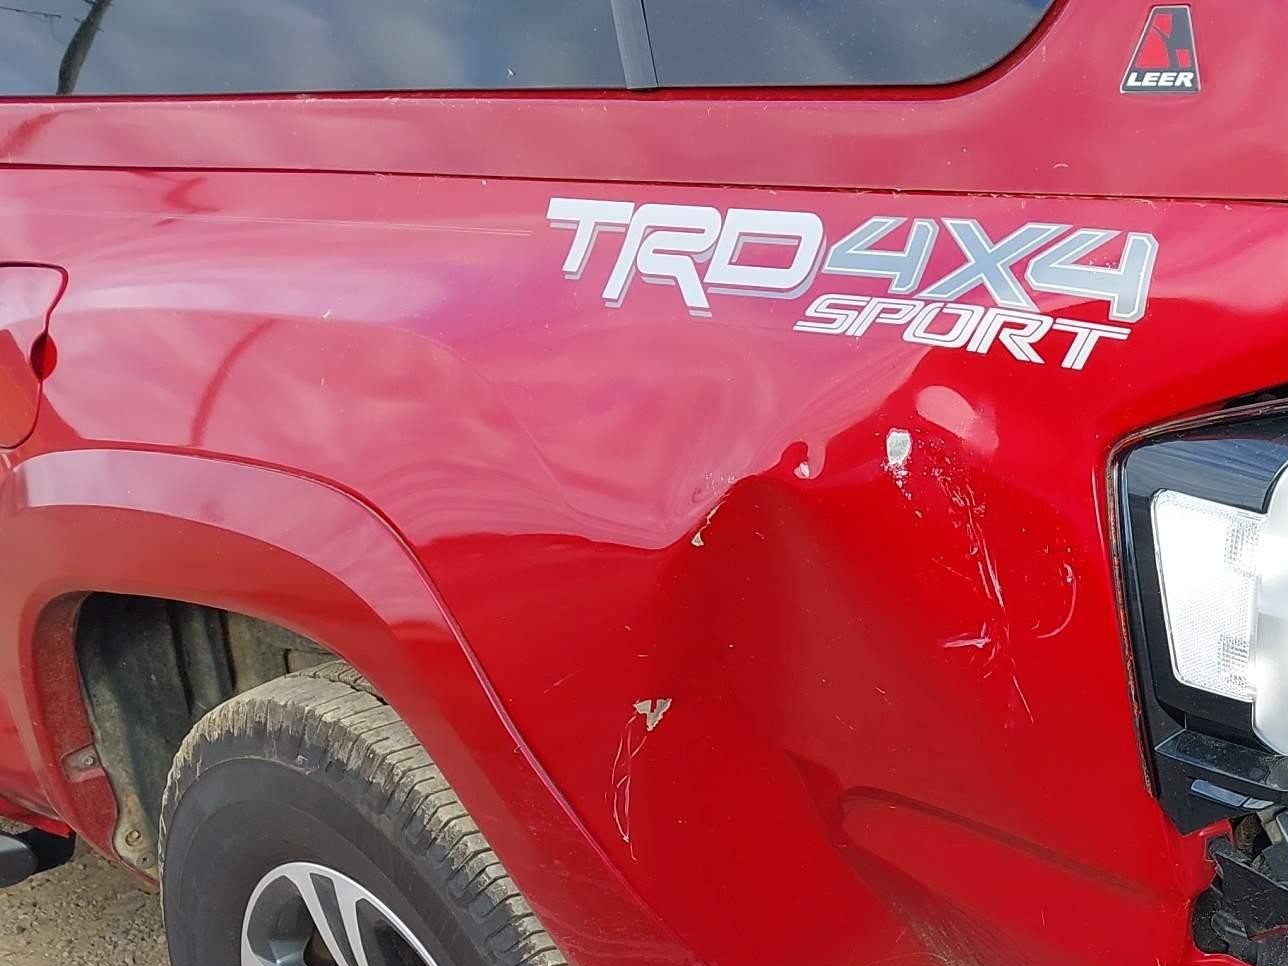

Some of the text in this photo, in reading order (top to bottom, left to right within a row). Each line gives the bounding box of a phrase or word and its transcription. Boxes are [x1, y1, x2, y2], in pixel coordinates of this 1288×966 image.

[1126, 72, 1194, 88] LEER
[545, 197, 827, 317] TRD
[792, 293, 1131, 371] SPORT
